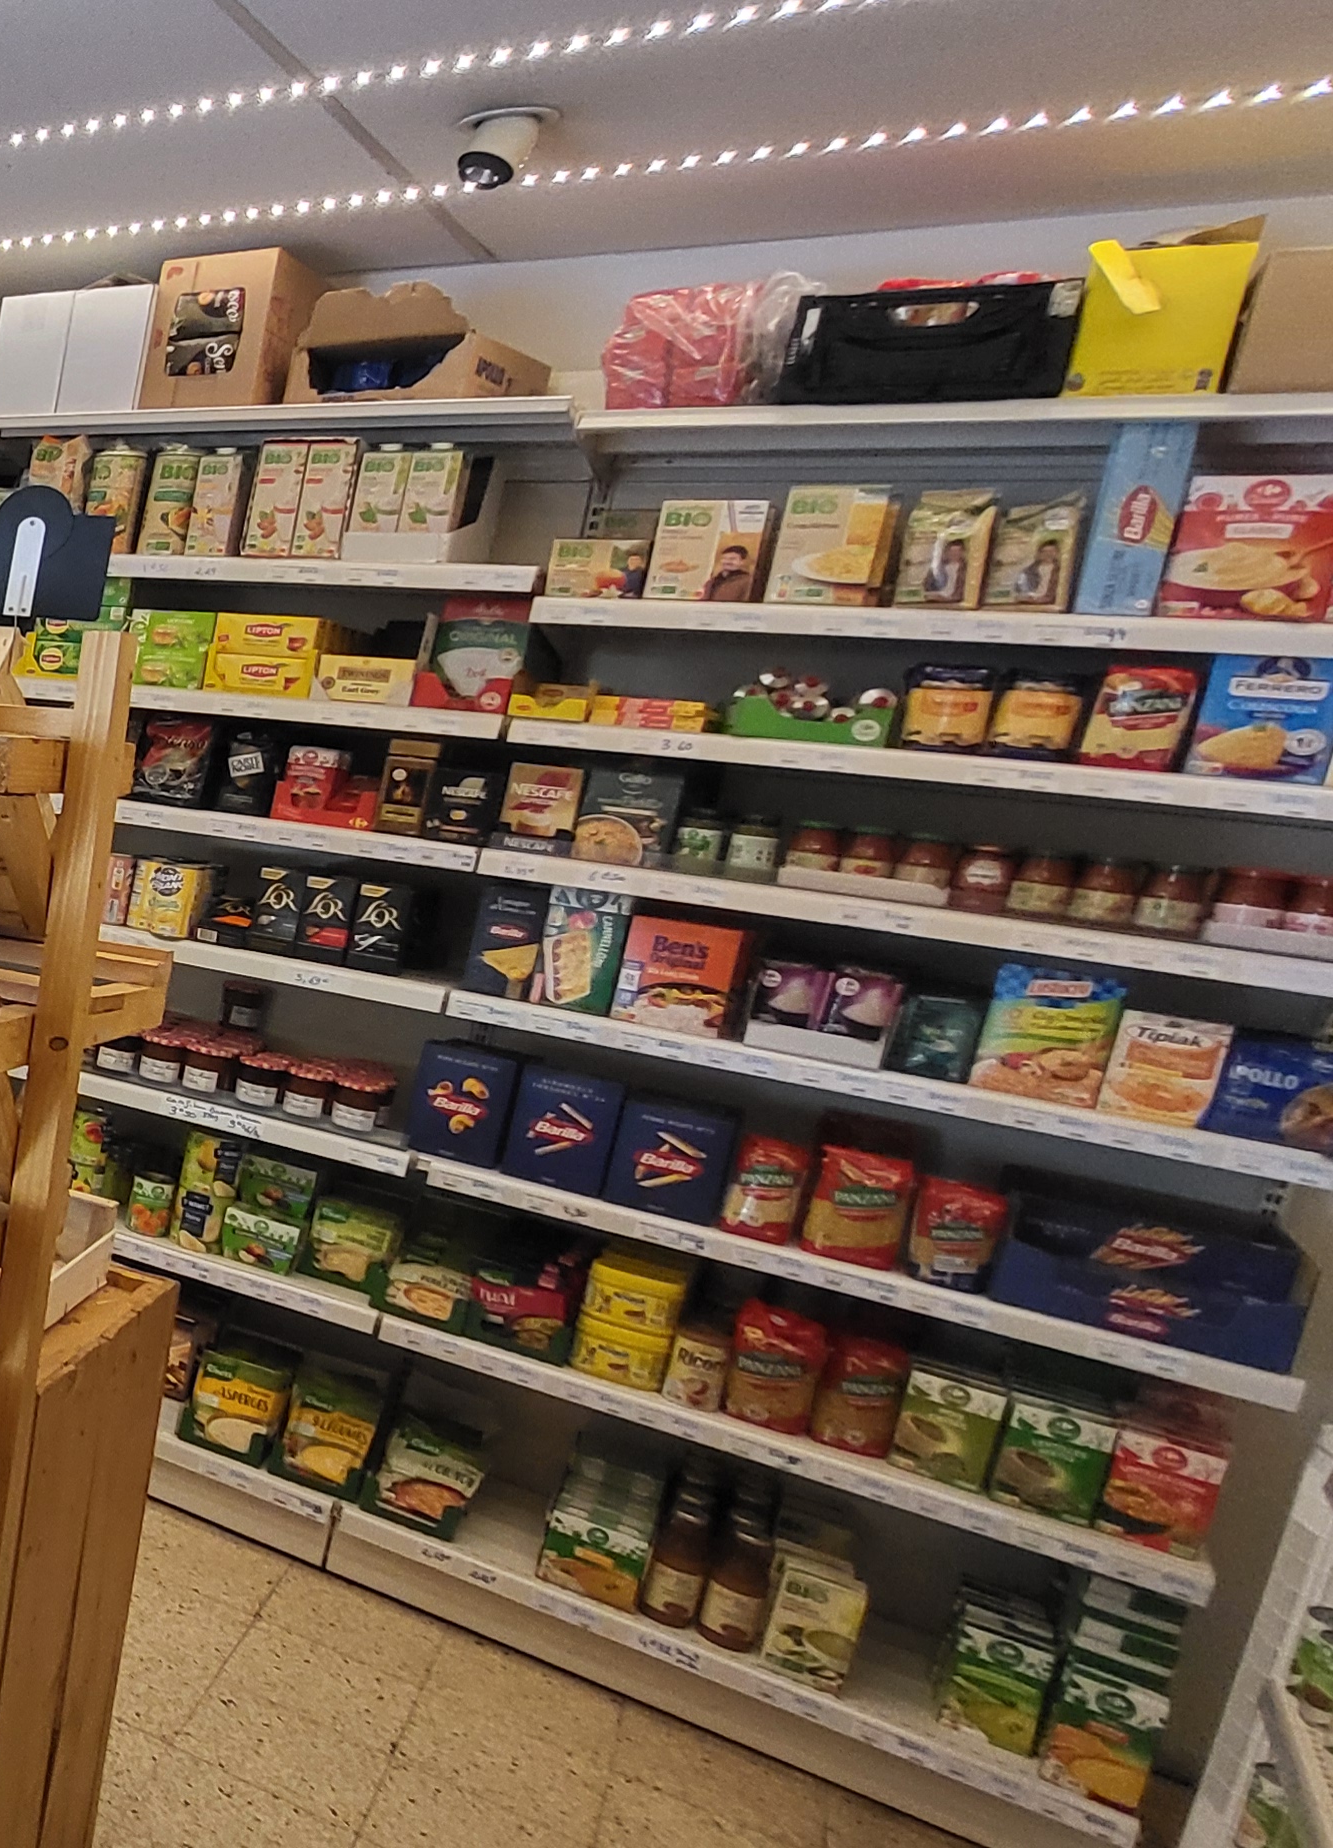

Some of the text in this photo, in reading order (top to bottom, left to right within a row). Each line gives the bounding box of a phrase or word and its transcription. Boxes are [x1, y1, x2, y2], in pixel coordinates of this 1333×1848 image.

[264, 452, 293, 465] BIO
[311, 452, 341, 465] BIO
[364, 460, 395, 473] BIO
[412, 460, 445, 473] BIO
[159, 463, 198, 480] BIO
[202, 464, 229, 475] BIO
[790, 496, 839, 515] BIO
[664, 510, 712, 528] BIO
[1123, 491, 1151, 541] Barilla
[245, 624, 282, 636] LIPTON
[449, 630, 518, 646] ORIGINAL
[242, 664, 278, 677] LIPTON
[1234, 679, 1323, 696] FERRERO
[653, 934, 711, 959] Ben's
[649, 950, 706, 971] Original
[432, 1097, 482, 1117] Barilla
[534, 1121, 586, 1142] Barilla
[639, 1152, 697, 1174] Barilla
[219, 1386, 269, 1414] ASPERGES
